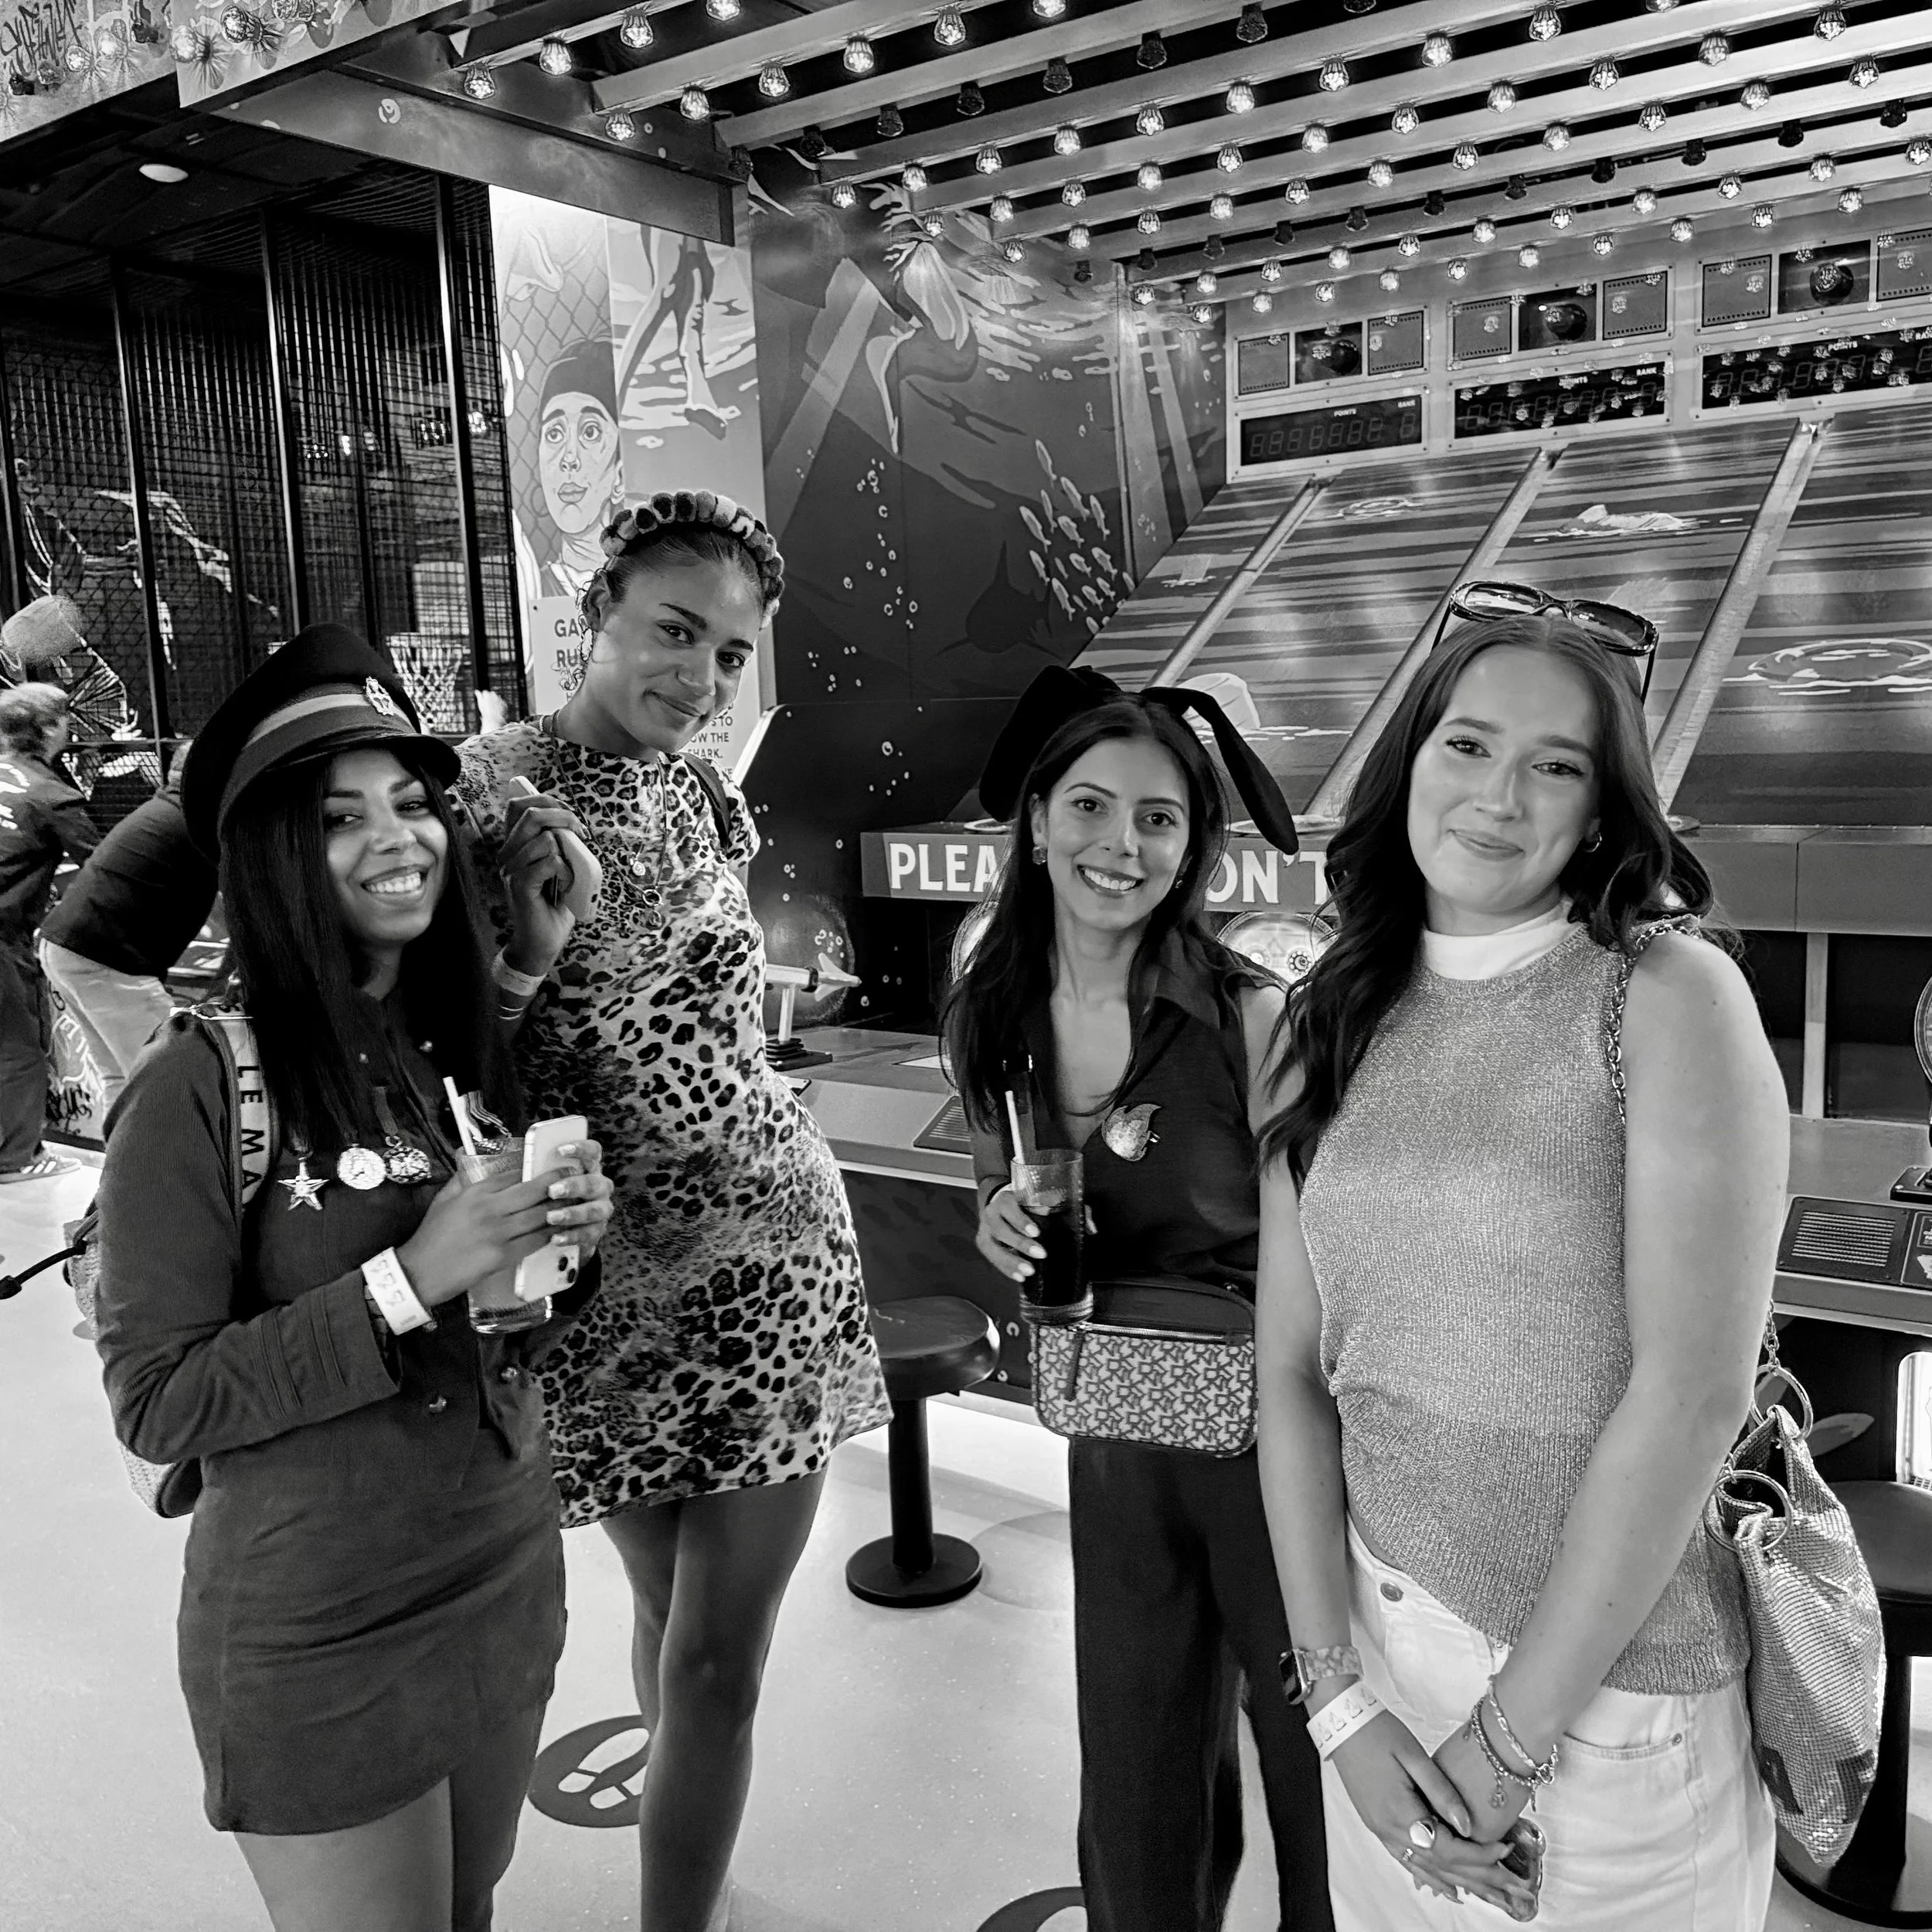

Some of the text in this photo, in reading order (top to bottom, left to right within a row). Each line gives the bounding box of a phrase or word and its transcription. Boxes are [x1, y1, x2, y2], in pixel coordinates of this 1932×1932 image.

[554, 617, 587, 637] GA
[710, 732, 730, 743] THE
[889, 842, 1332, 906] PLEA ON'T
[237, 1065, 263, 1104] LE
